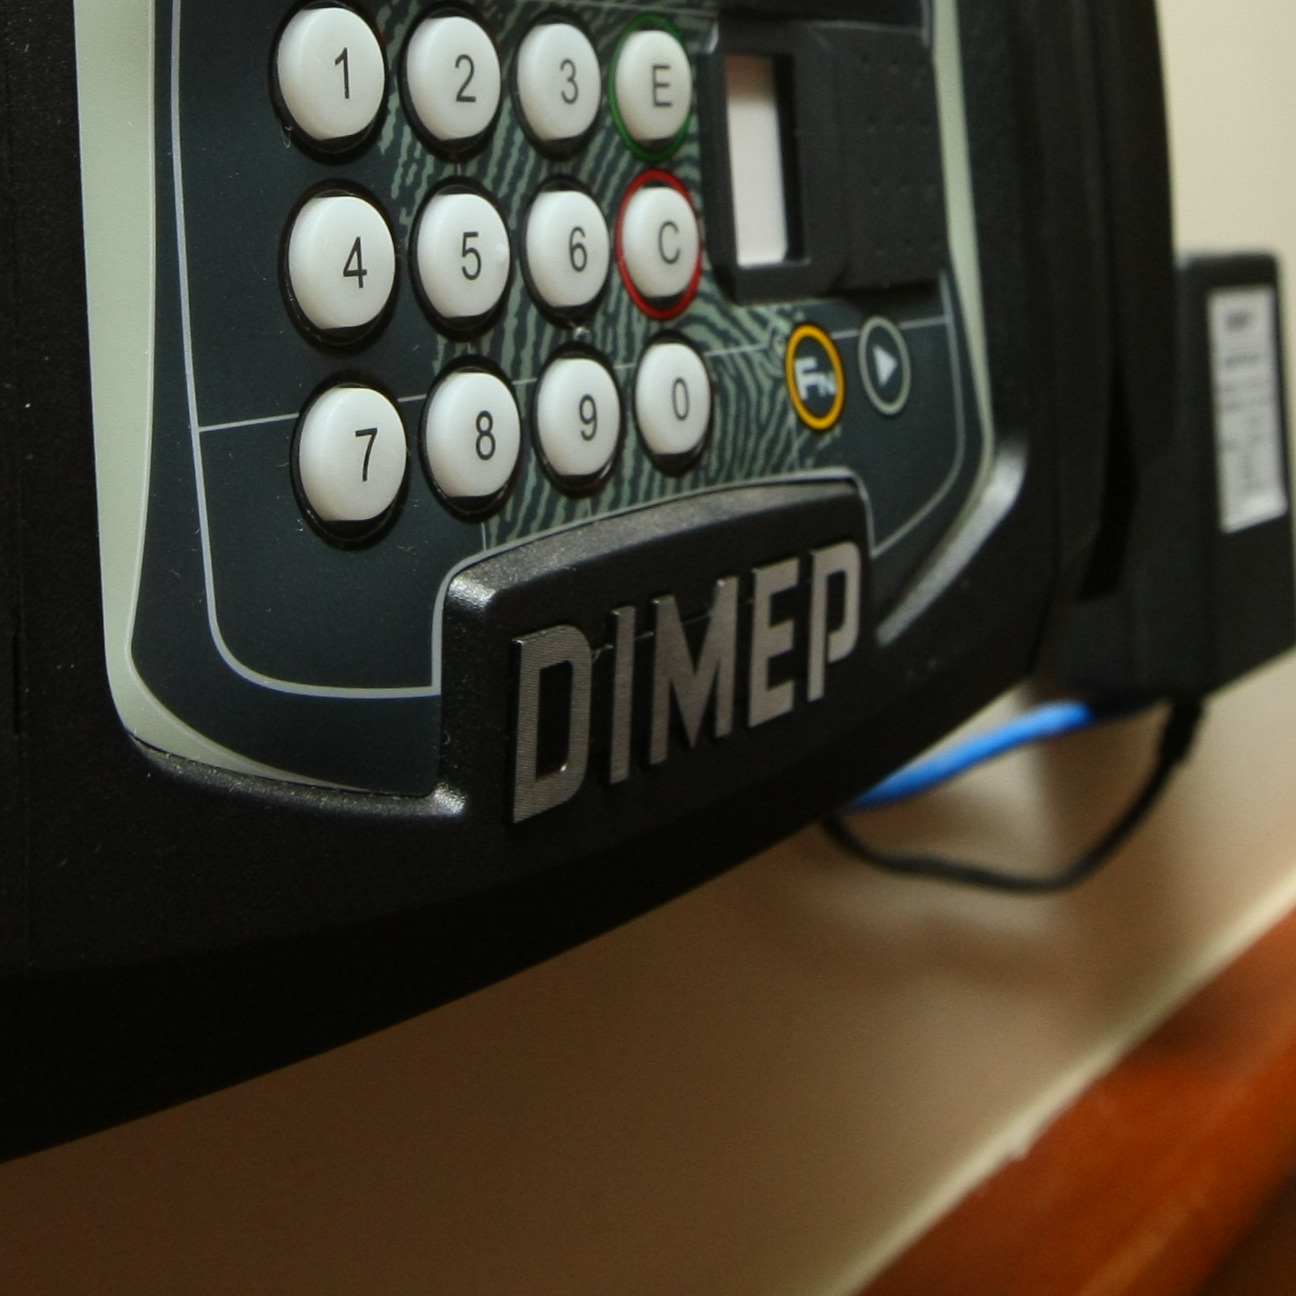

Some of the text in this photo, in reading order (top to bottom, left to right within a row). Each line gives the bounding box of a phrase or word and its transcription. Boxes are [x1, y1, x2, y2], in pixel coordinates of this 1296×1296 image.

[334, 47, 350, 100] 1
[454, 54, 477, 103] 2
[559, 59, 579, 104] 3
[651, 64, 672, 108] E
[342, 236, 368, 289] 4
[461, 231, 482, 281] 5
[568, 226, 588, 273] 6
[657, 221, 681, 265] C
[578, 394, 598, 441] 9
[671, 377, 690, 421] 0
[354, 427, 379, 482] 7
[475, 410, 496, 461] 8
[512, 540, 861, 824] DIMEP
